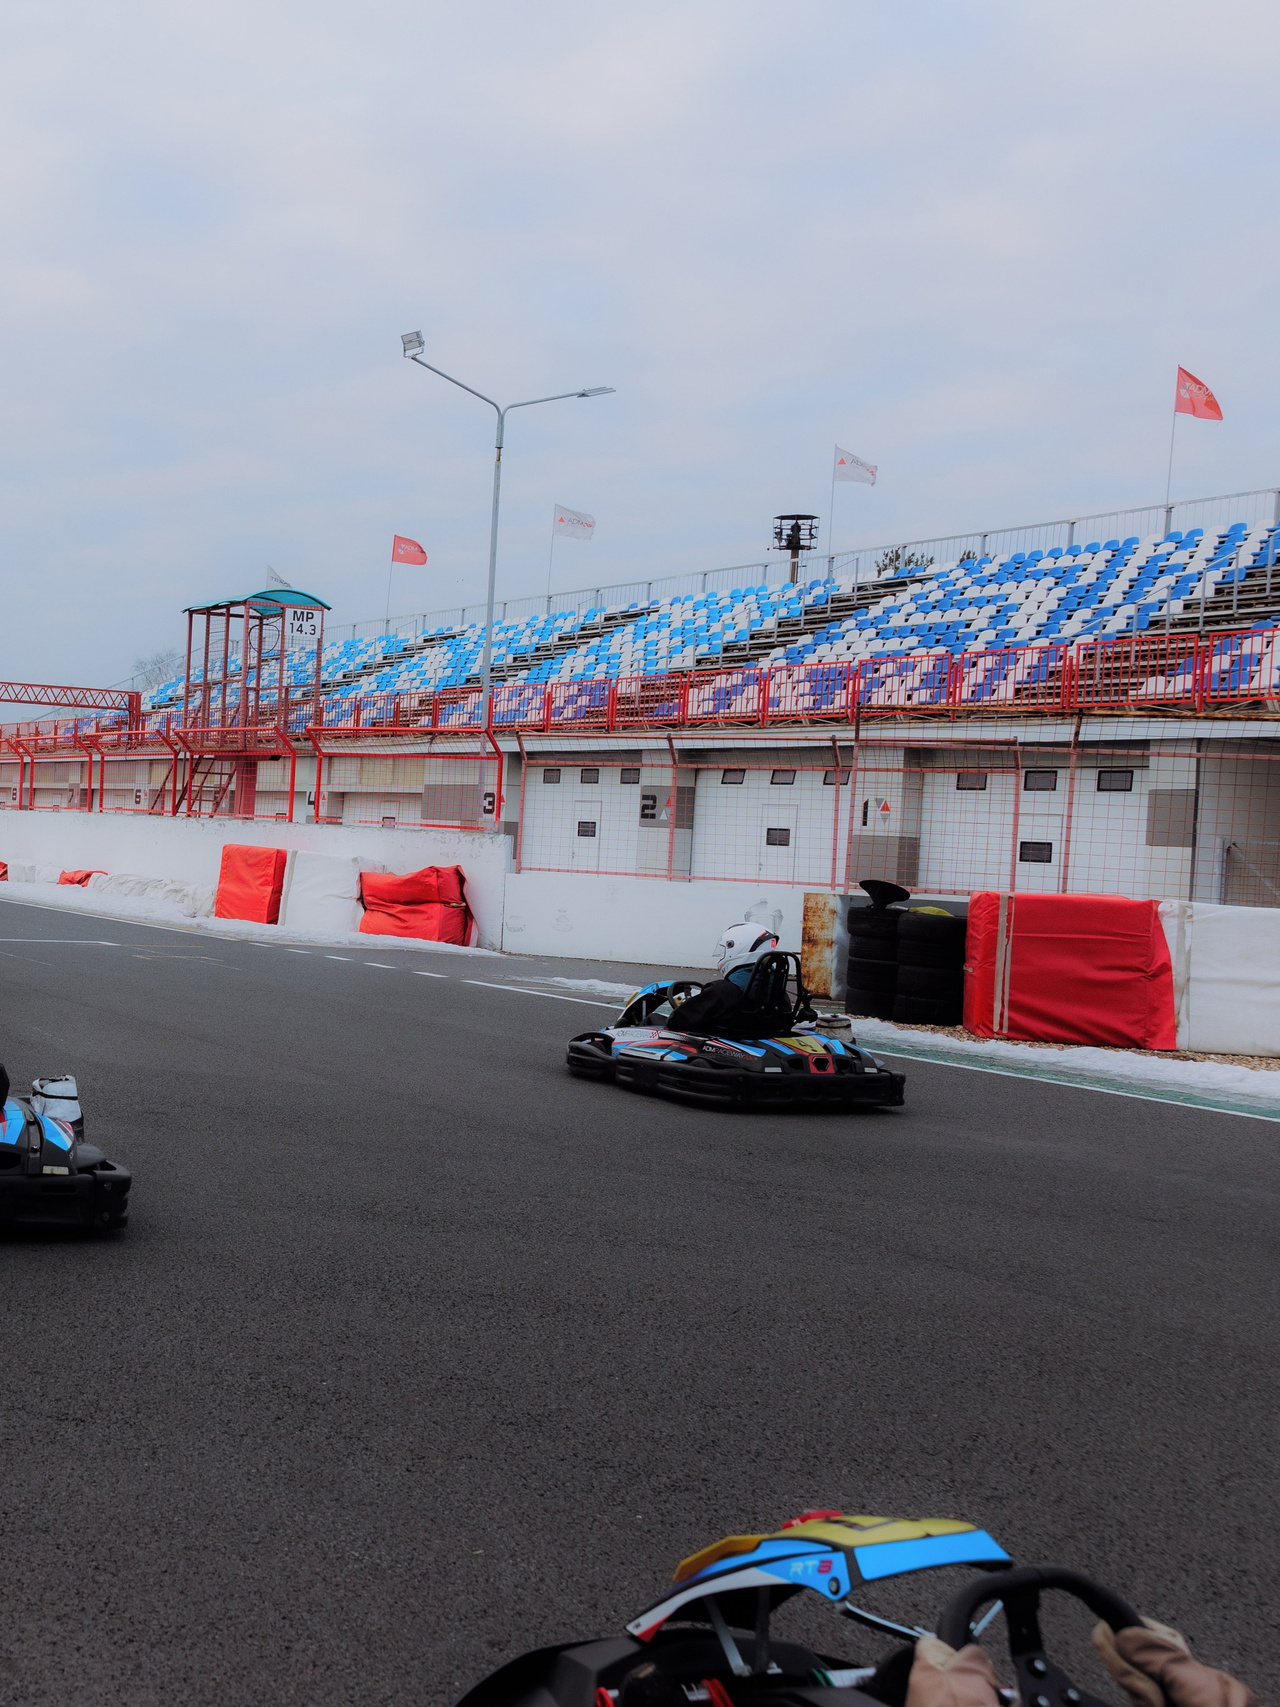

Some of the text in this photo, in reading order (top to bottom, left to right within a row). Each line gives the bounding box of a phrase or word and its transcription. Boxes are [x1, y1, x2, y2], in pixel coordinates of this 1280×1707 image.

[292, 610, 315, 622] MP
[290, 622, 317, 636] 14.3
[68, 789, 74, 803] 7
[135, 789, 141, 804] 6
[483, 792, 495, 814] 3
[640, 794, 658, 819] 2
[795, 1038, 814, 1049] 4
